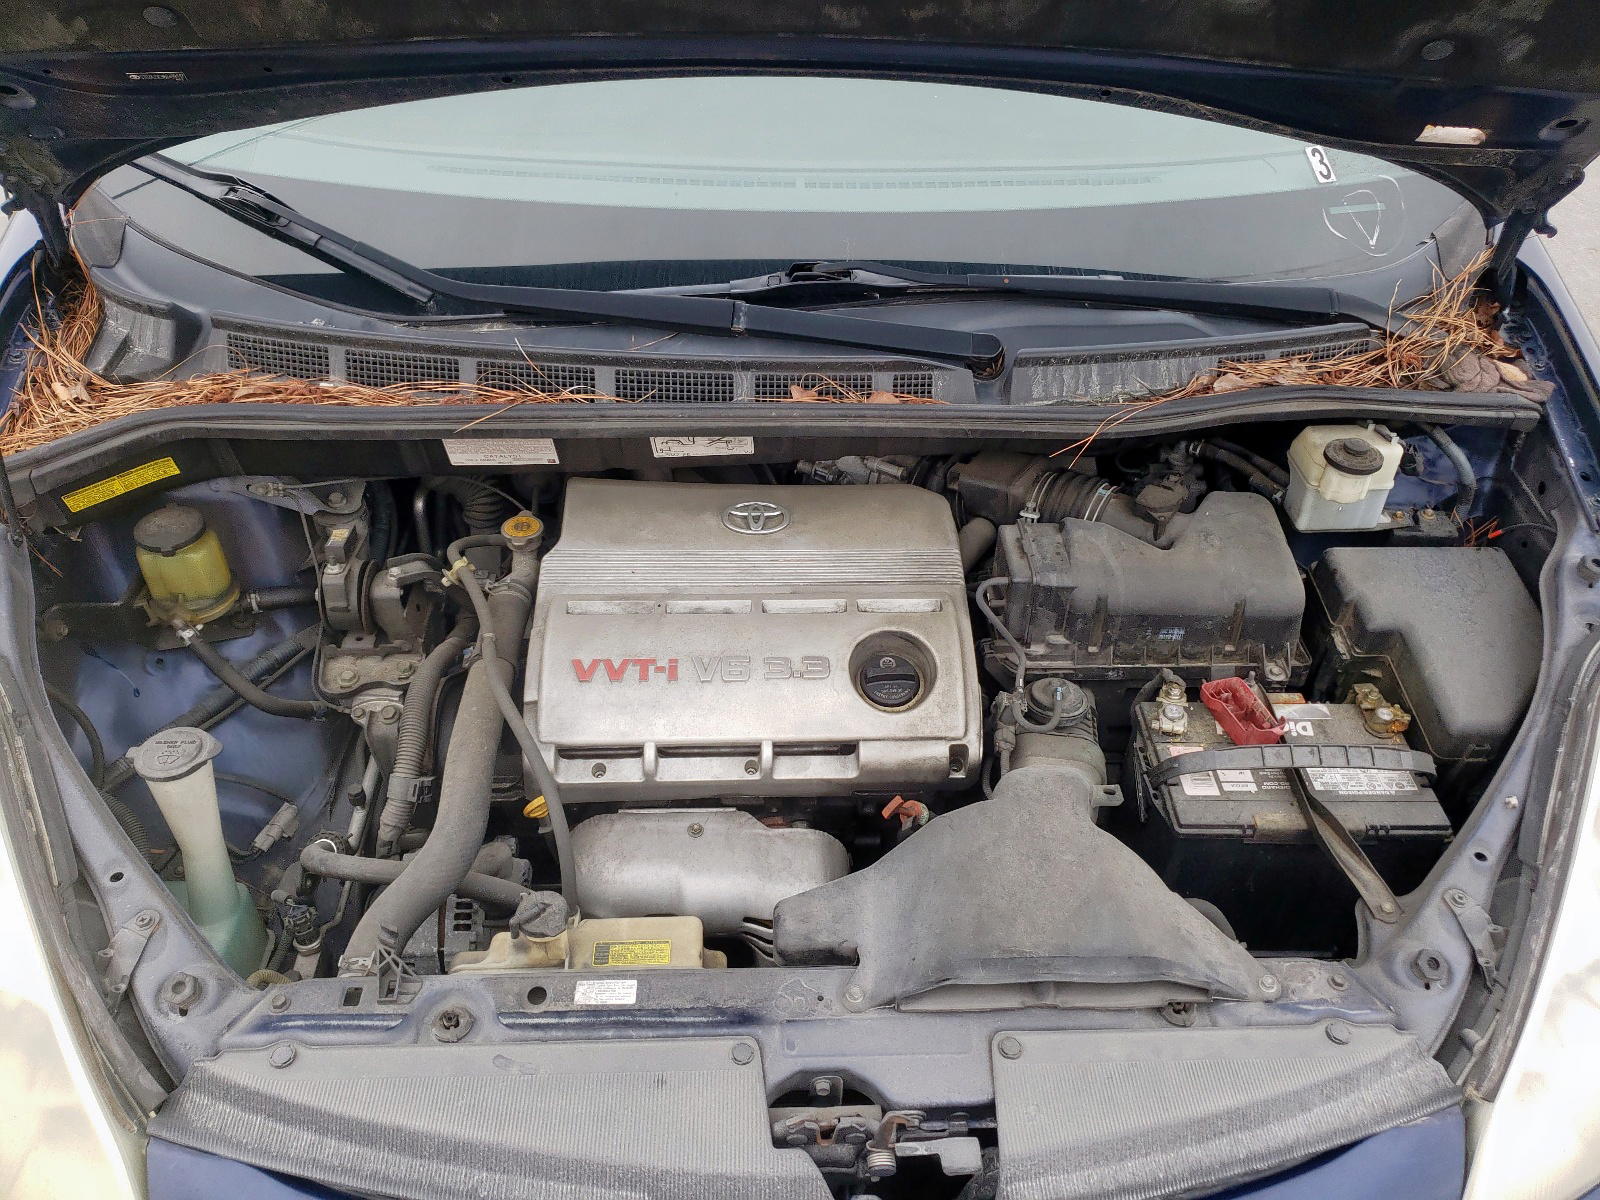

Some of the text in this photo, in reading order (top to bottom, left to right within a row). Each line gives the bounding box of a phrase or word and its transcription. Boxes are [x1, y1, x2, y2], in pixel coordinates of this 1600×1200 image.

[1310, 147, 1332, 181] 3
[571, 656, 831, 683] VVT-i V6 3.3
